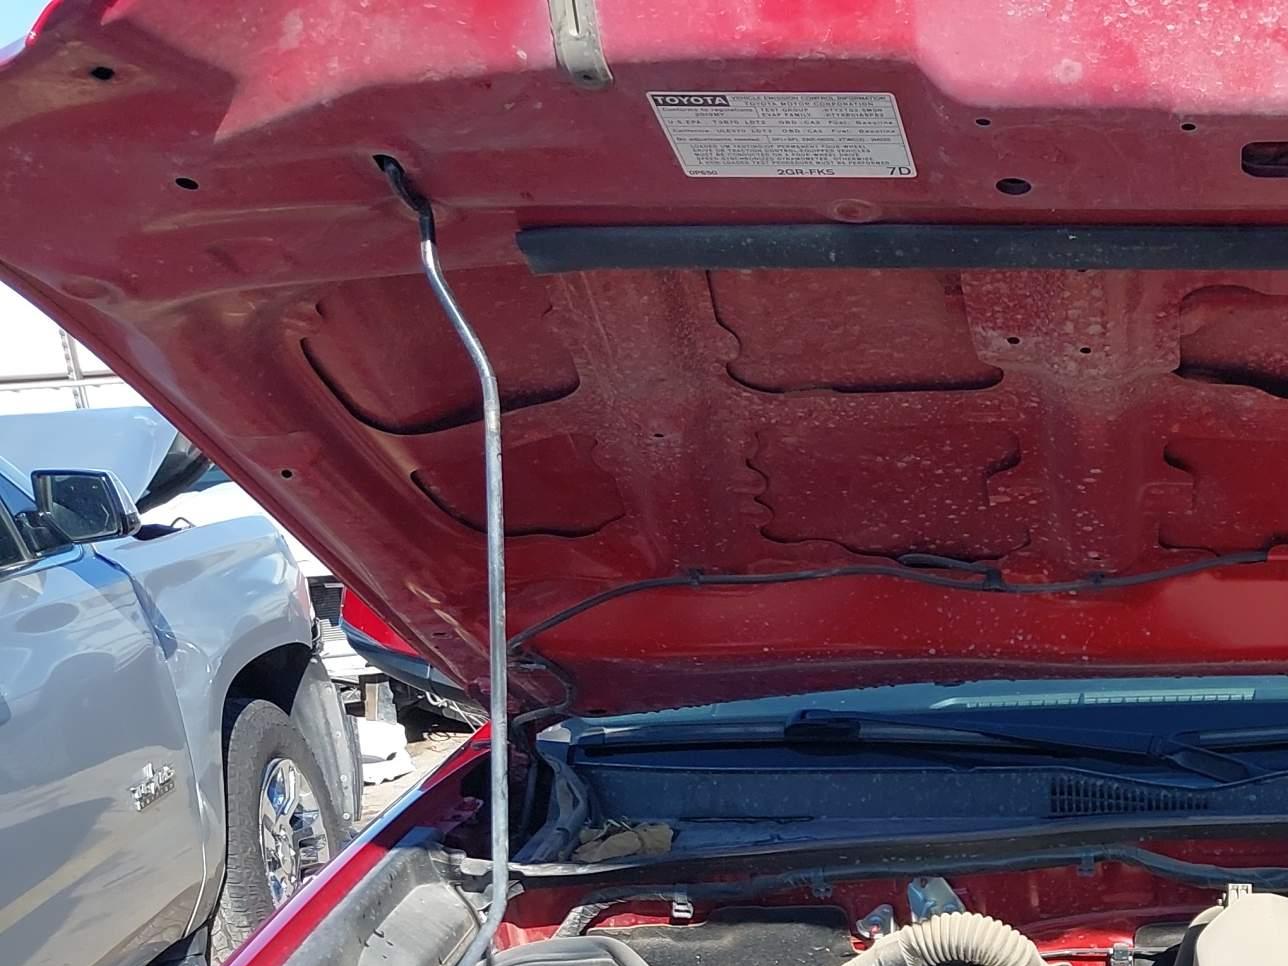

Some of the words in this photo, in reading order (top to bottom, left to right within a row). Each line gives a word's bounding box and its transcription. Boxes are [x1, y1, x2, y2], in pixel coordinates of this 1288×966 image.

[653, 96, 728, 105] TOYOTA
[777, 168, 835, 176] 2GR-FKS
[887, 166, 912, 176] 7D
